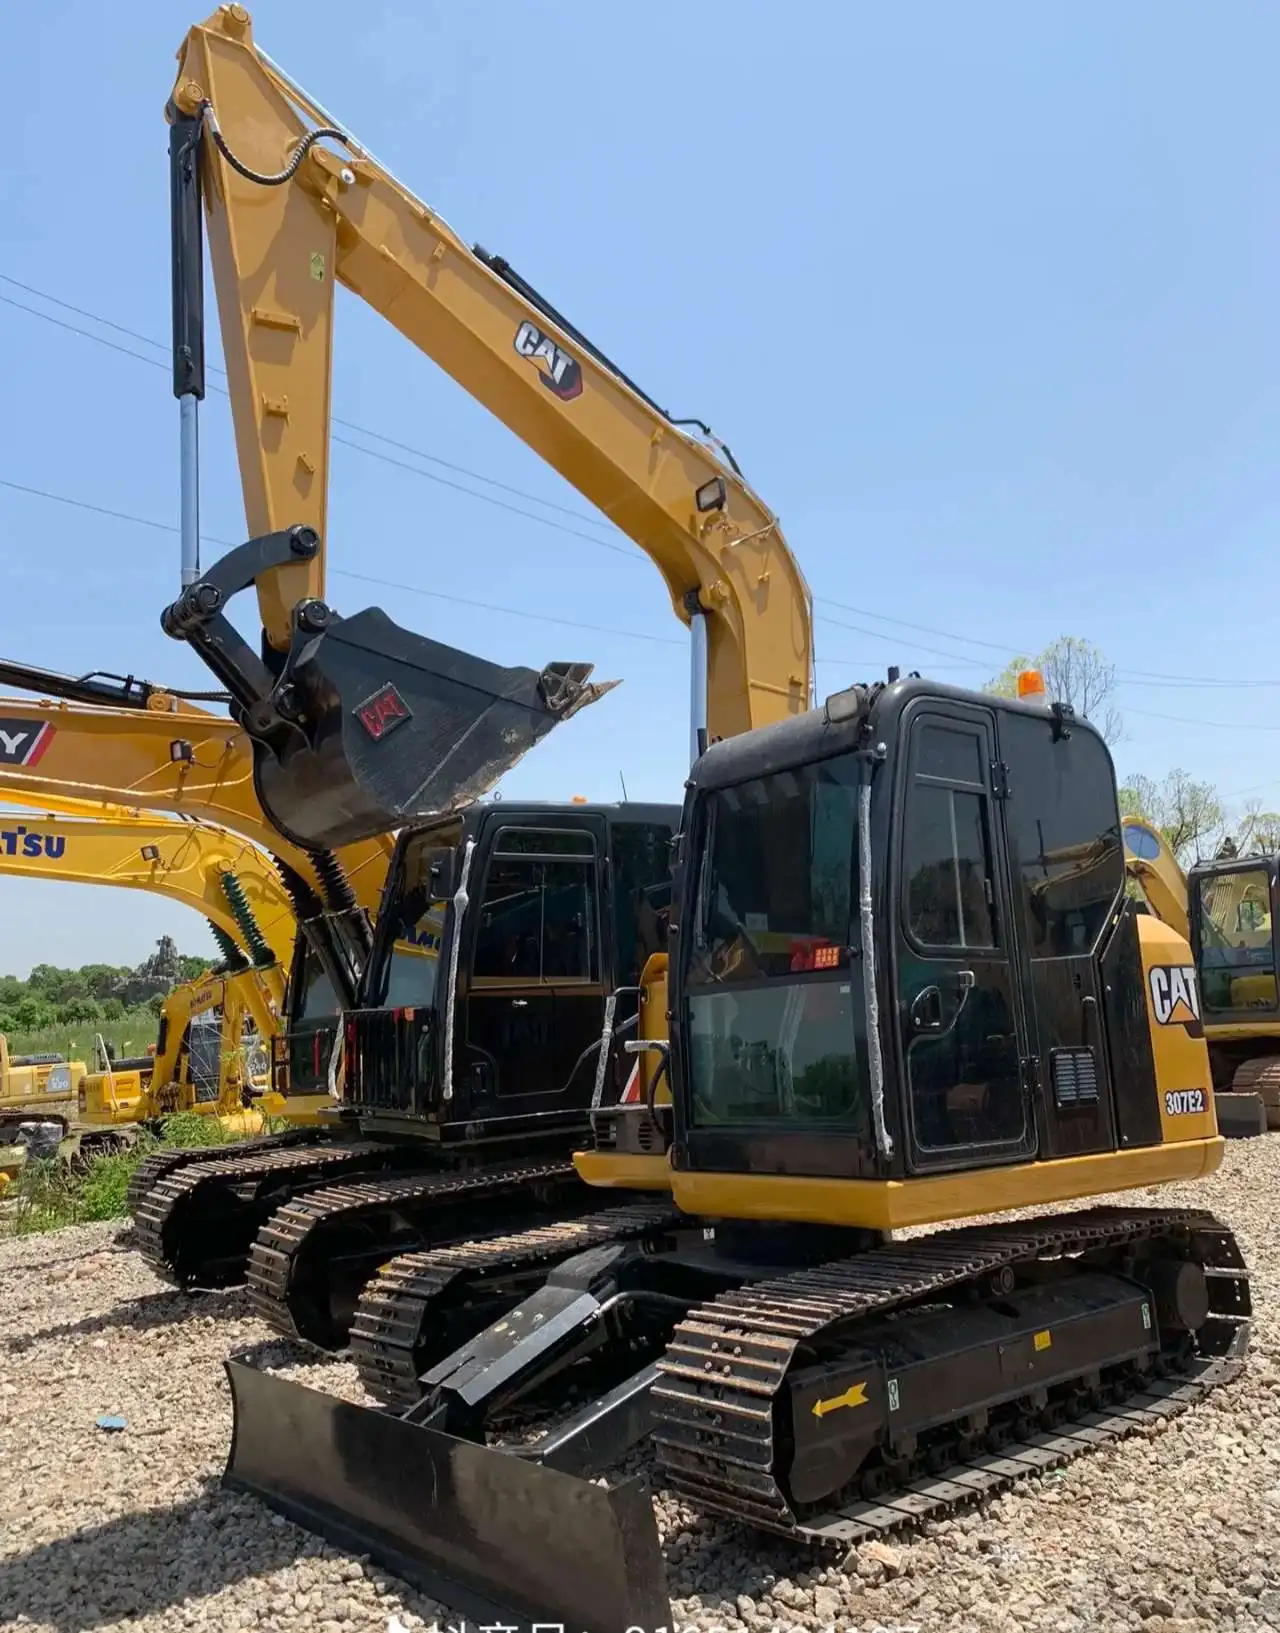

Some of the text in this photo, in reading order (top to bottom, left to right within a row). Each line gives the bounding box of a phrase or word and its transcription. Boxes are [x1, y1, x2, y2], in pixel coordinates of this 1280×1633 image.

[515, 322, 573, 385] CAT
[360, 693, 405, 737] CAT
[0, 826, 66, 859] TSU
[1150, 967, 1200, 1024] CAT
[1165, 1090, 1204, 1116] 307E2
